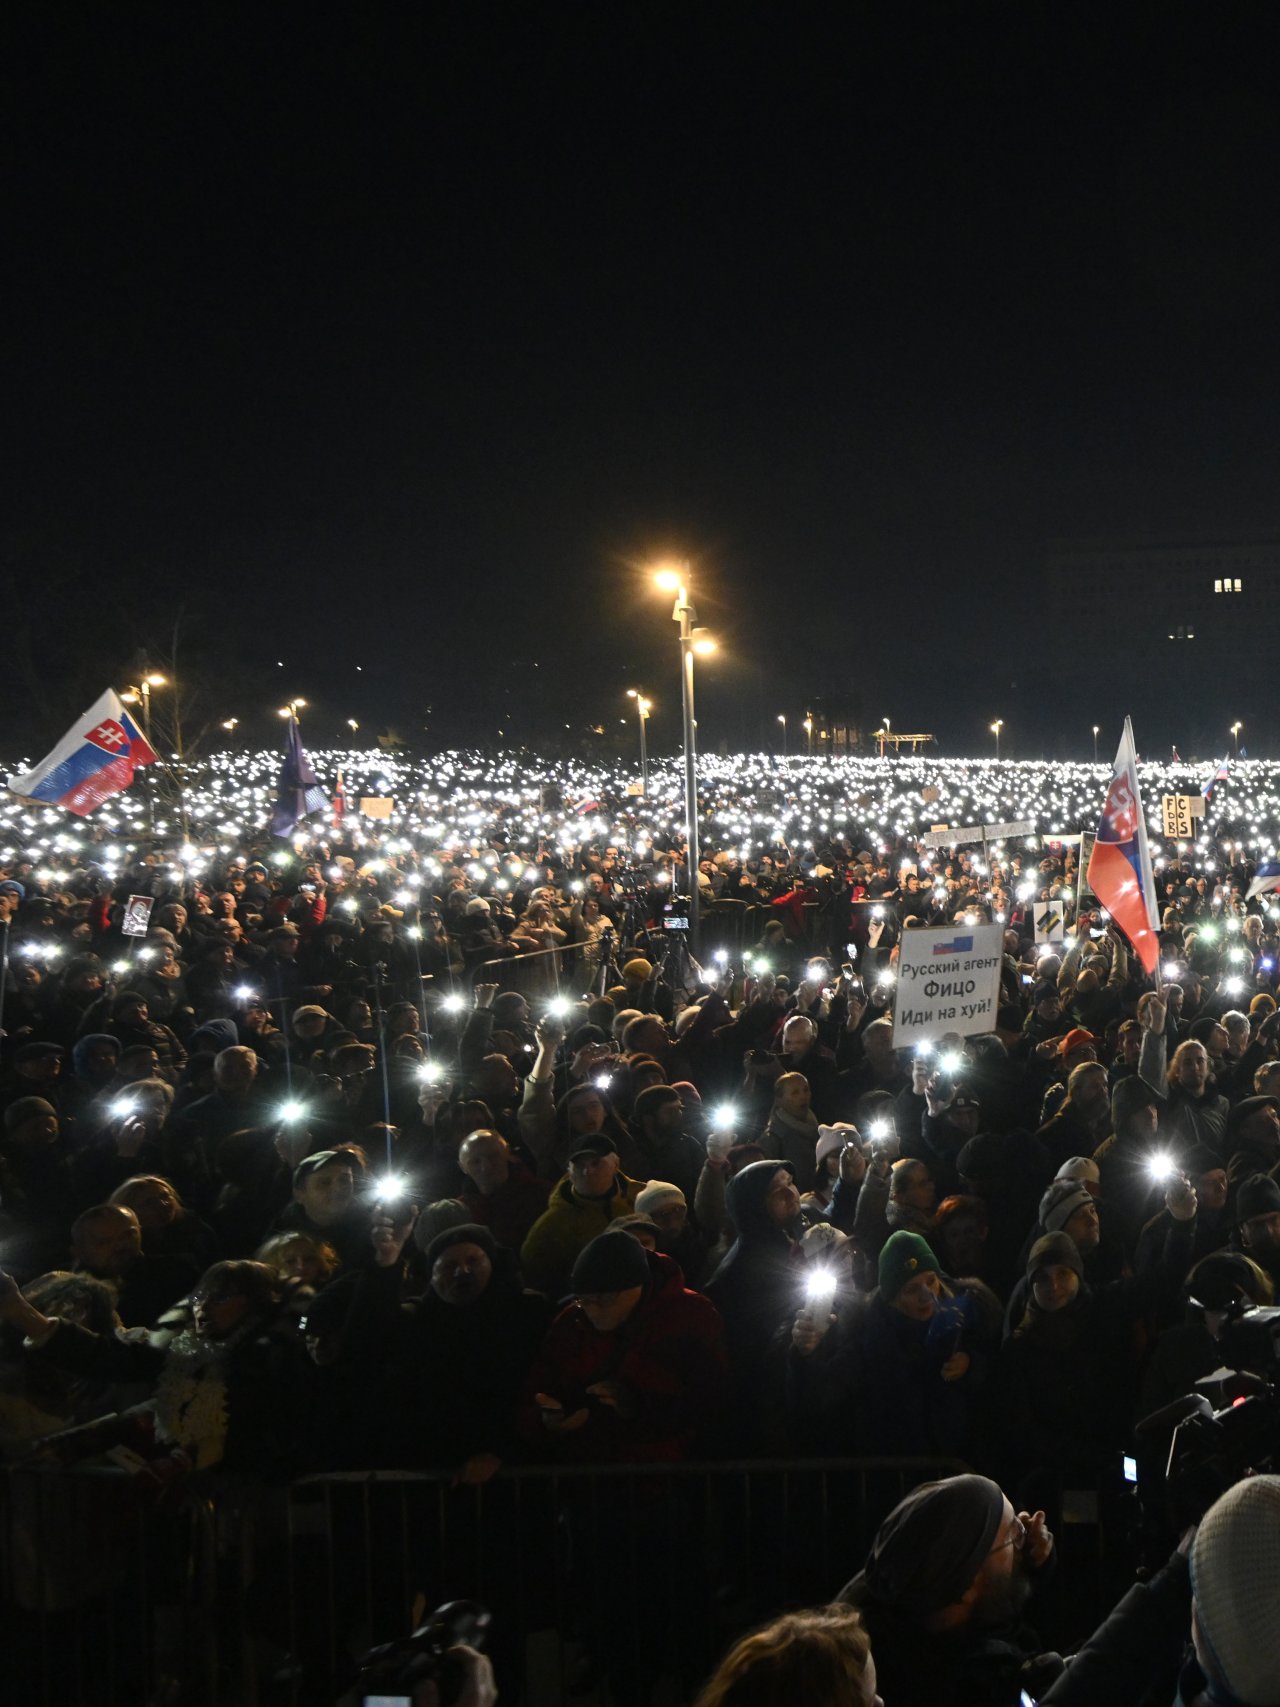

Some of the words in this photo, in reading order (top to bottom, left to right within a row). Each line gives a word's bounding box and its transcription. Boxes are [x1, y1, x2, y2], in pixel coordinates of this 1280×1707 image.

[901, 959, 960, 980] Русский
[964, 957, 1000, 971] агент
[924, 980, 975, 998] Фицо
[901, 1009, 933, 1026] Иди
[938, 1007, 956, 1020] на
[961, 998, 992, 1019] хуй!
